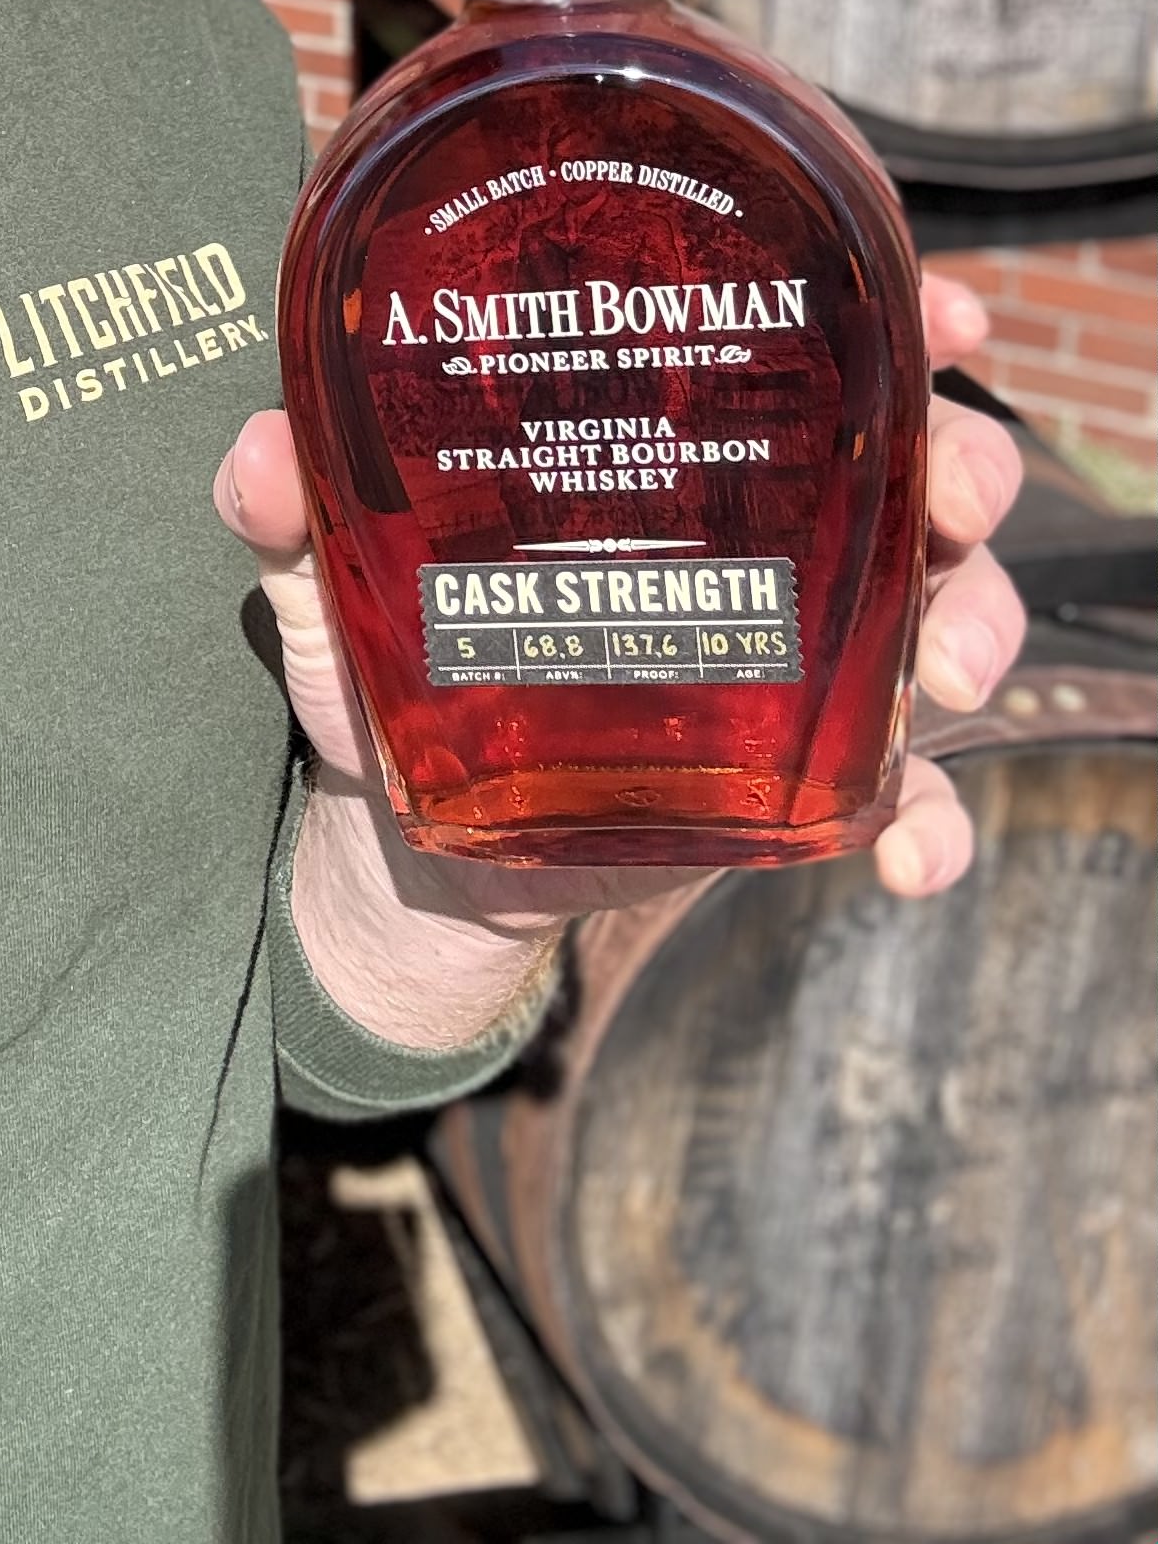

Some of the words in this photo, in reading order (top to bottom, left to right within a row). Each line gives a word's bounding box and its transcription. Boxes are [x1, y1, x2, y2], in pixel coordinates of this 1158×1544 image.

[429, 186, 488, 233] SMALL
[487, 165, 547, 201] BATCH
[561, 160, 633, 183] COPPER
[637, 164, 735, 216] DISTILLED
[382, 291, 429, 346] A.
[433, 288, 584, 343] SMITH
[585, 279, 808, 336] BOWMAN
[480, 350, 609, 375] PIONEER
[617, 345, 716, 370] SPIRIT
[521, 416, 676, 443] VIRGINIA
[437, 444, 601, 472] STRAIGHT
[608, 439, 771, 466] BOURBON
[529, 467, 678, 494] WHISKEY
[435, 571, 544, 616] CASK
[556, 568, 778, 614] STRENGTH
[456, 637, 476, 659] 5
[523, 634, 584, 659] 68.8
[612, 632, 678, 659] 137.6
[701, 631, 729, 656] 10
[736, 630, 787, 656] YRS
[452, 671, 491, 682] BATCH
